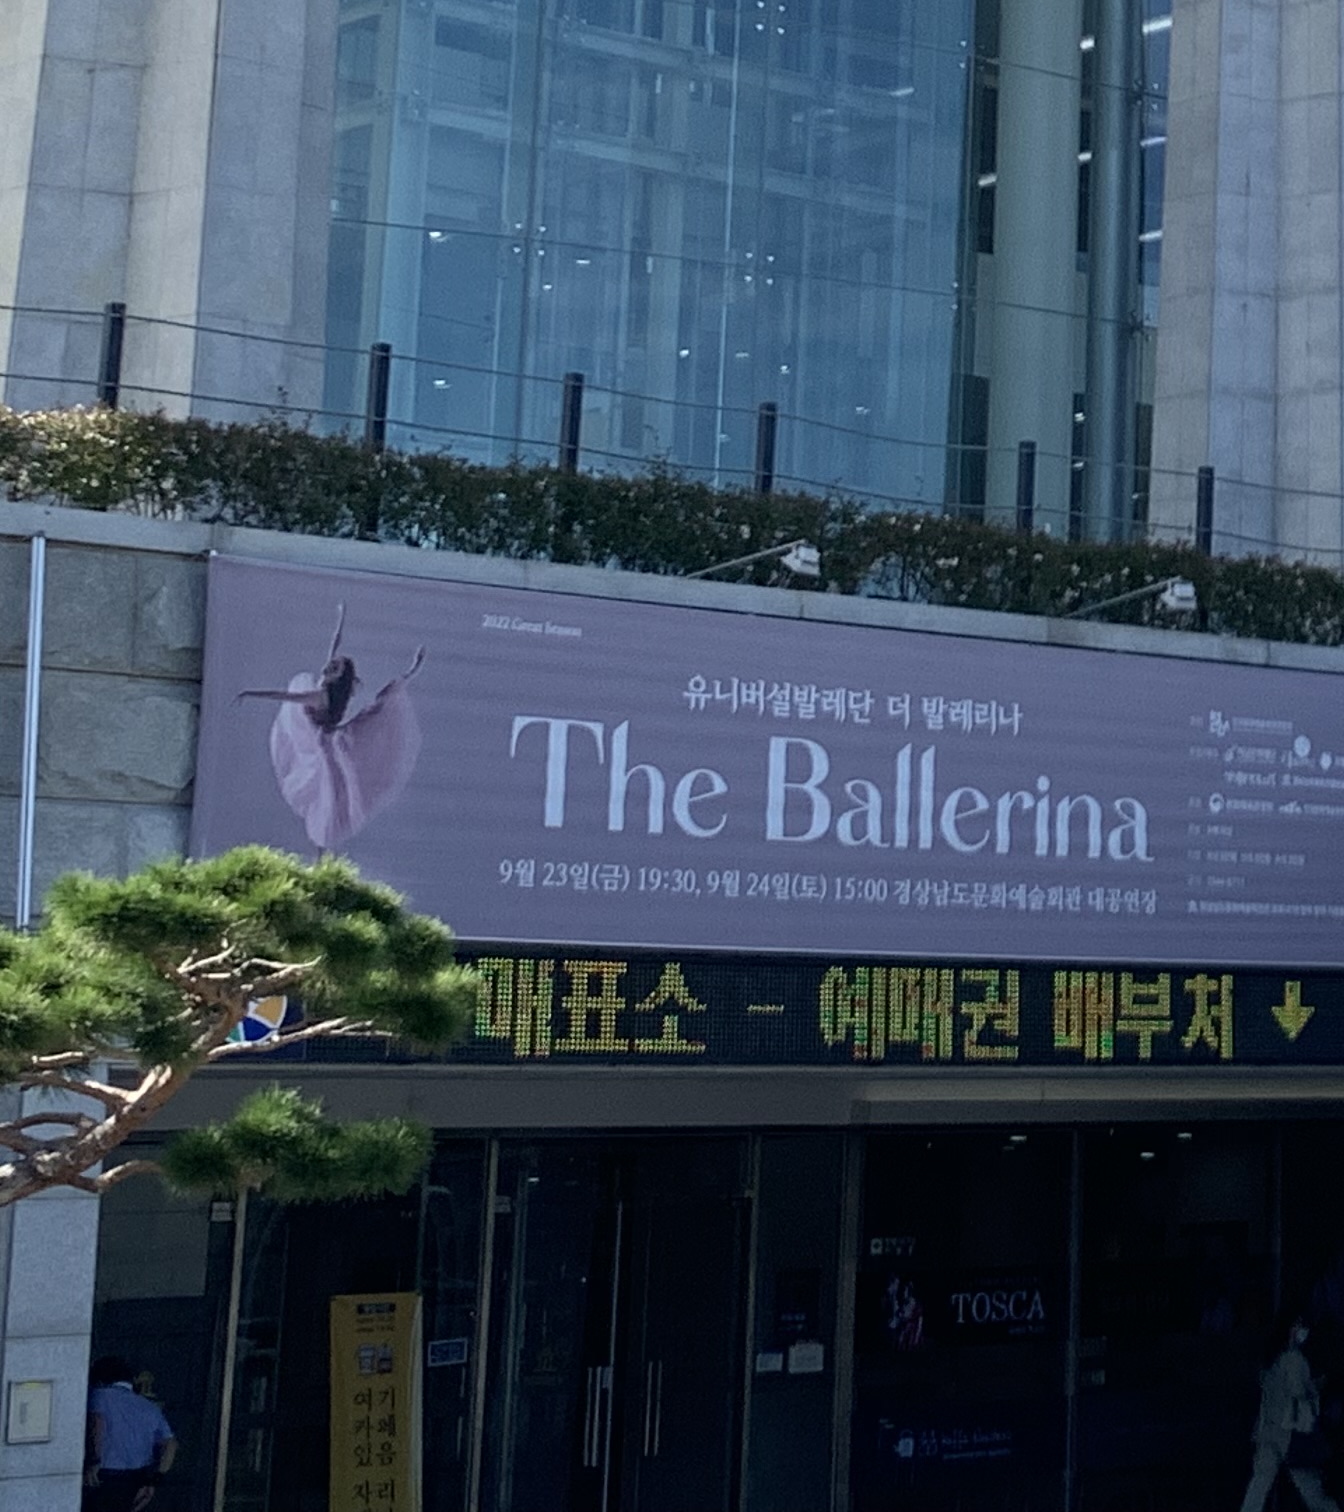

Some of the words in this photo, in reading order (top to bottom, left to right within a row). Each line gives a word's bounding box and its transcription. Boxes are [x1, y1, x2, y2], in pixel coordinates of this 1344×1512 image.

[683, 675, 875, 724] 유니버설발레단
[887, 694, 911, 730] 더
[921, 696, 1023, 735] 발레리나
[510, 715, 729, 838] The
[766, 735, 1156, 862] Ballerina
[499, 859, 535, 887] 9월
[542, 862, 630, 892] 23일(금)
[637, 867, 701, 895] 19:30,
[706, 870, 740, 897] 9월
[746, 872, 827, 902] 24일(토)
[835, 877, 888, 902] 15:00
[893, 879, 1082, 911] 경상남도문화예술회관
[1087, 888, 1157, 915] 대공연장
[475, 957, 707, 1058] 매표소
[819, 966, 1020, 1060] 예매권
[1053, 970, 1234, 1060] 배부처
[951, 1290, 1046, 1324] TOSCA
